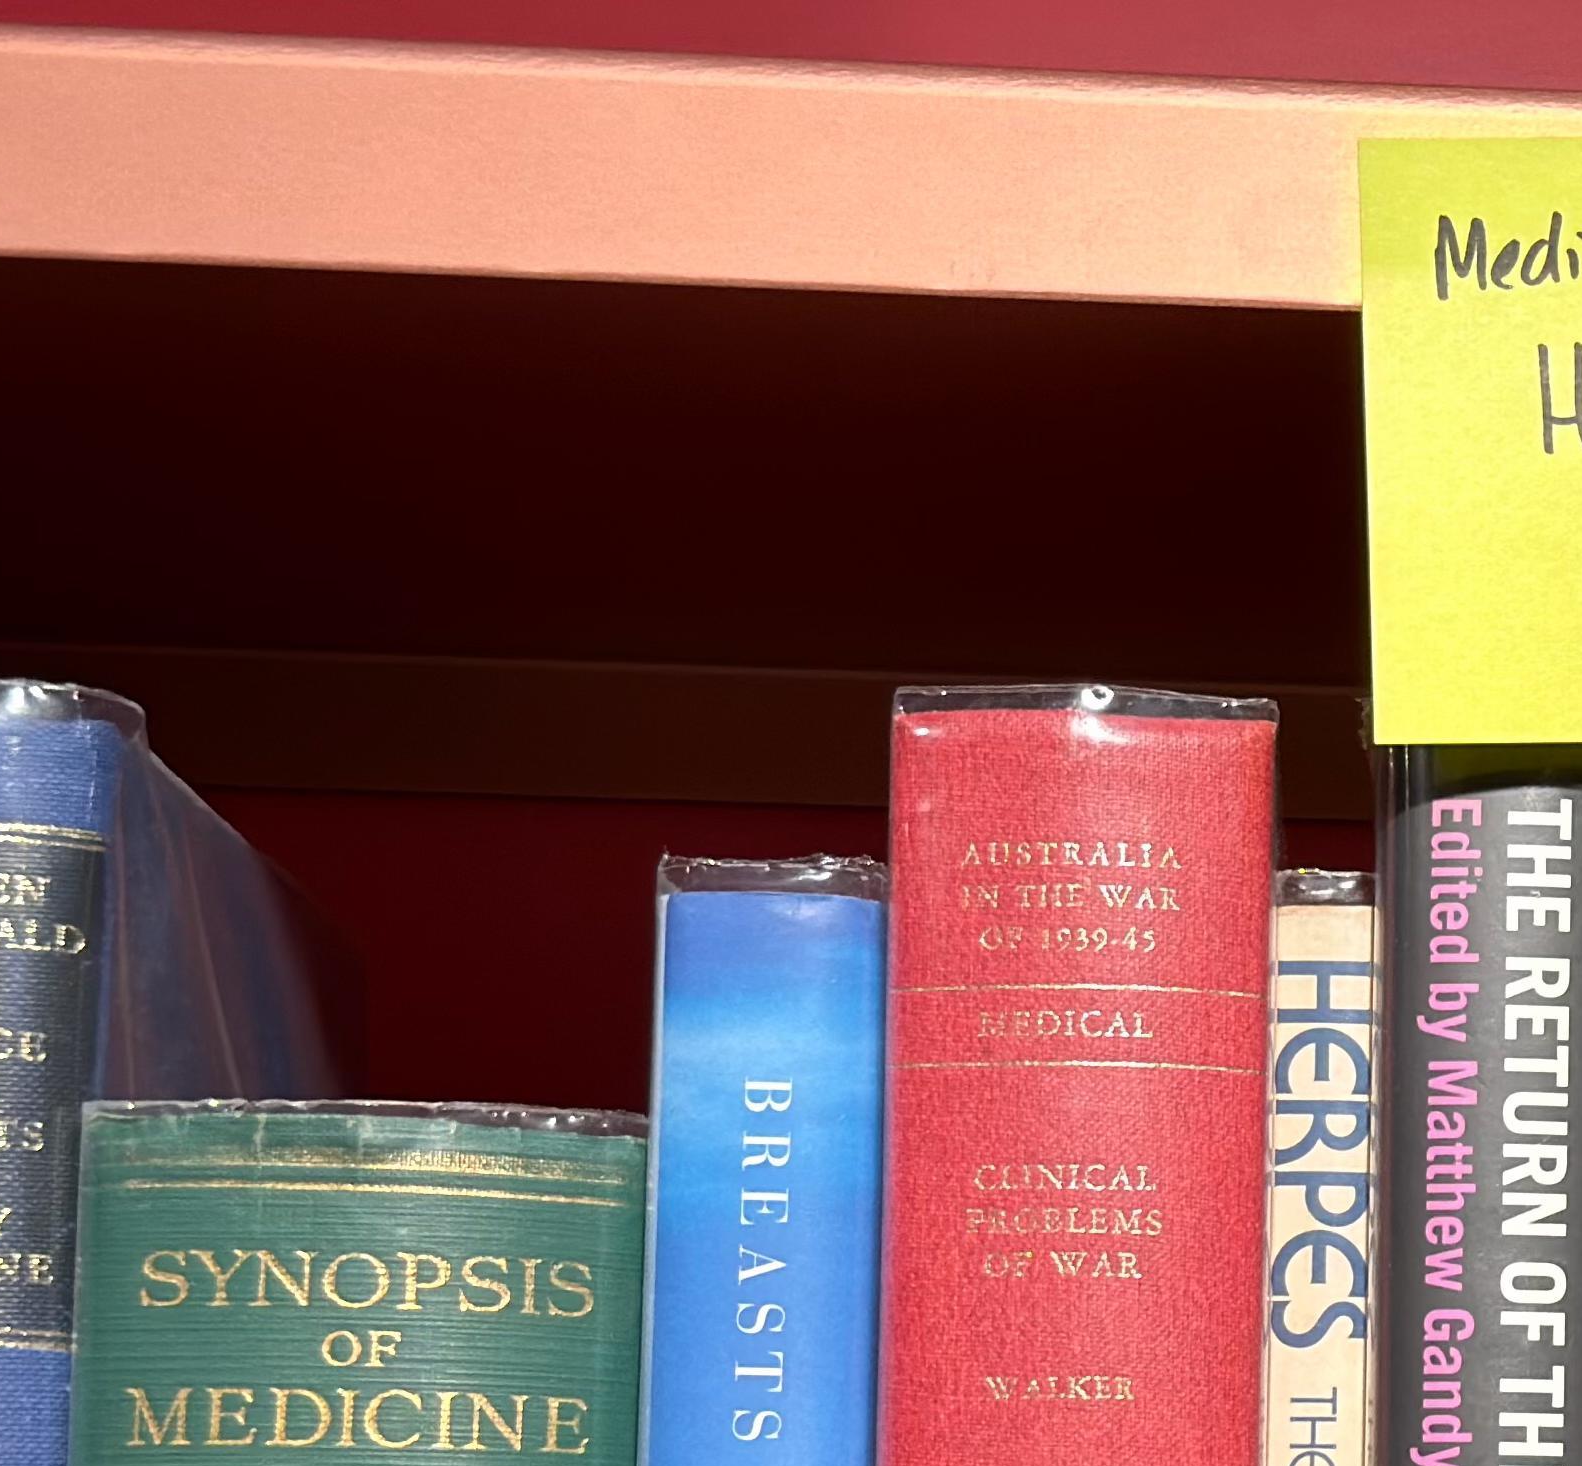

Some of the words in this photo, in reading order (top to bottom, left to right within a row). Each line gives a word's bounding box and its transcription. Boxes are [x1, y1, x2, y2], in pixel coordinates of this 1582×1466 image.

[963, 841, 1182, 869] AUSTRALIA
[1429, 800, 1482, 964] Edited
[1506, 799, 1572, 933] THE
[1017, 883, 1084, 908] THE
[1099, 884, 1180, 910] WAR
[979, 927, 1023, 949] OF
[1041, 927, 1156, 952] 1939-45
[978, 1010, 1153, 1038] MEDICAL
[1417, 983, 1480, 1041] by
[1501, 957, 1571, 1238] RETURN
[973, 1164, 1156, 1191] CLINICAL
[1270, 961, 1373, 1348] HERPES
[1424, 1062, 1479, 1292] Matthew
[966, 1207, 1163, 1236] PROBLEMS
[139, 1249, 595, 1318] SYNOPSIS
[732, 1078, 792, 1442] BREASTS
[984, 1251, 1033, 1278] OF
[1050, 1251, 1142, 1279] WAR
[1499, 1261, 1567, 1345] OF
[322, 1331, 401, 1368] OF
[986, 1376, 1134, 1400] WALKER
[125, 1388, 590, 1455] MEDICINE
